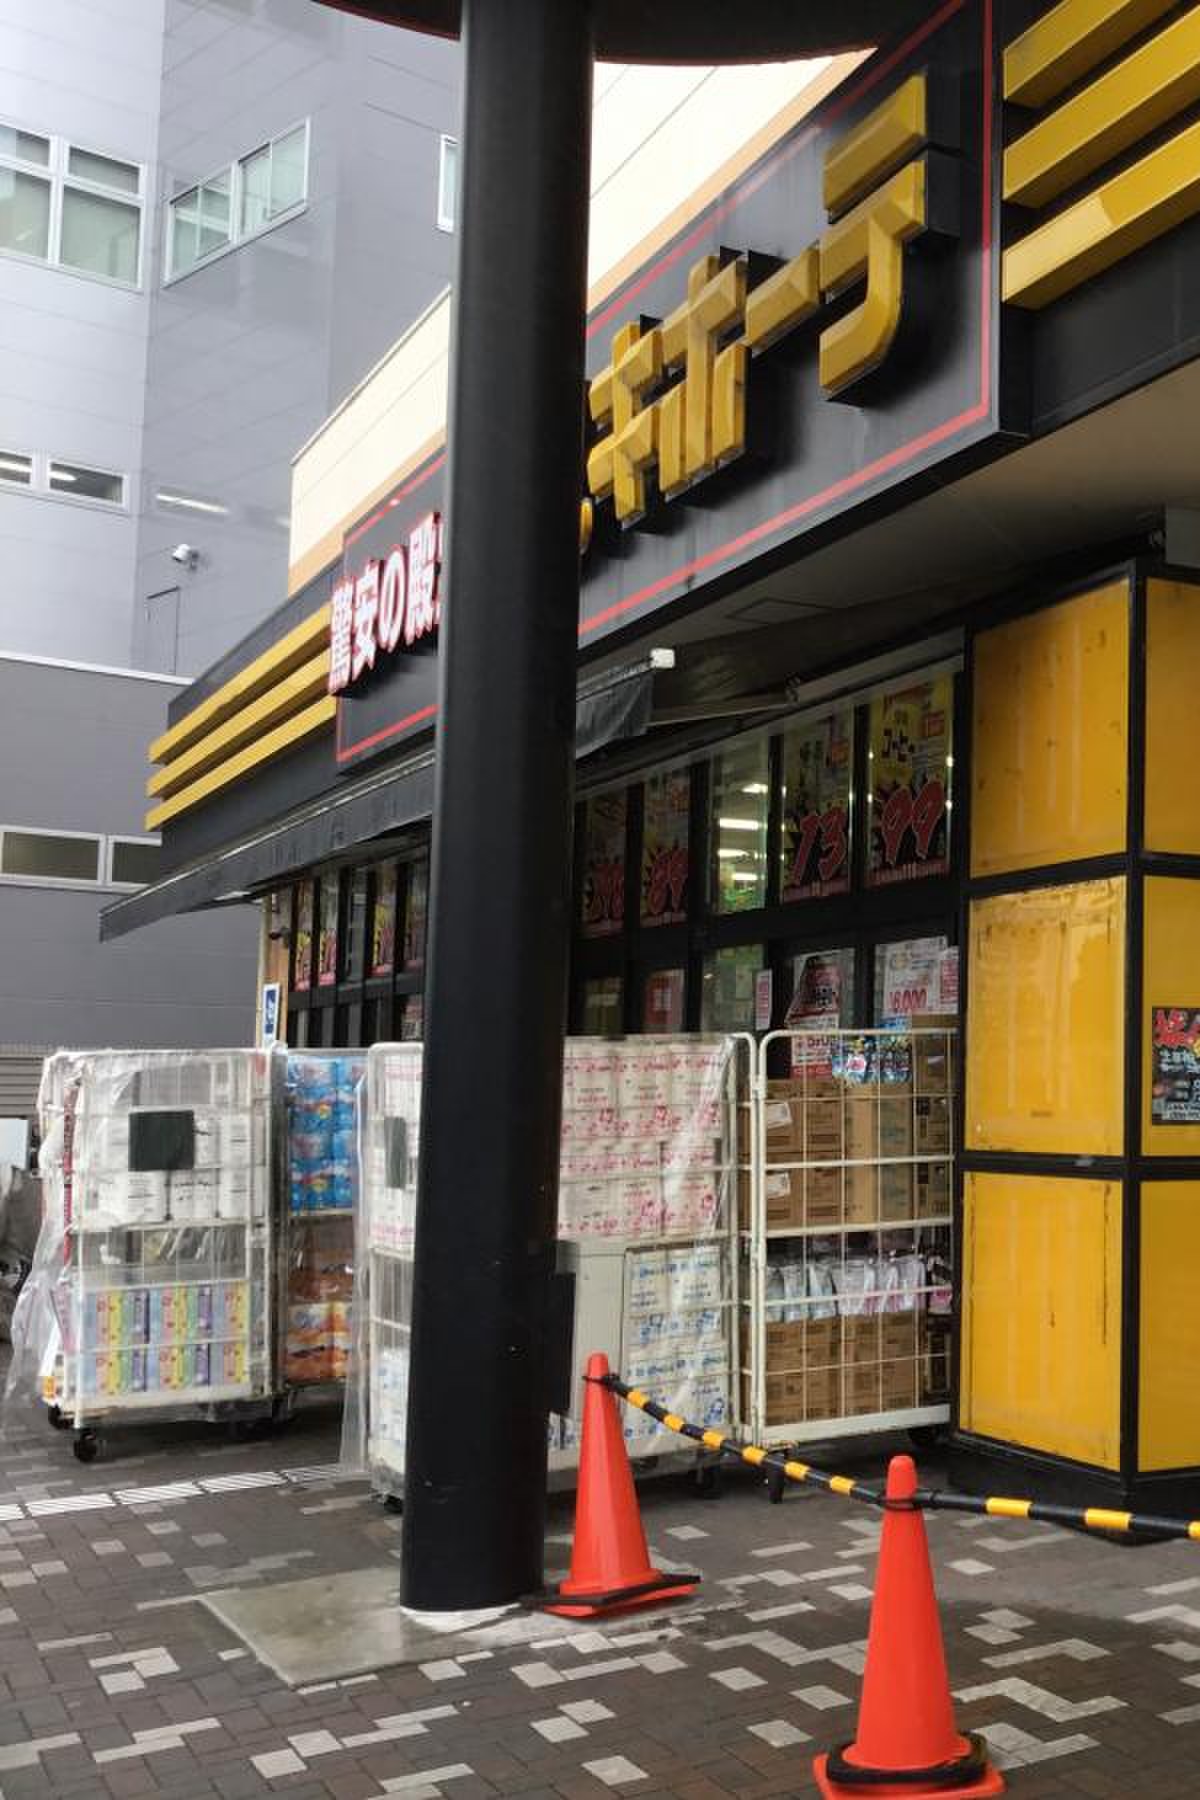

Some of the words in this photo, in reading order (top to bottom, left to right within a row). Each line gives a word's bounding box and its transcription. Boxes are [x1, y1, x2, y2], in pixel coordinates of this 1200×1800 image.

[580, 73, 927, 555] キホーテ
[328, 512, 443, 693] 驚安の殿
